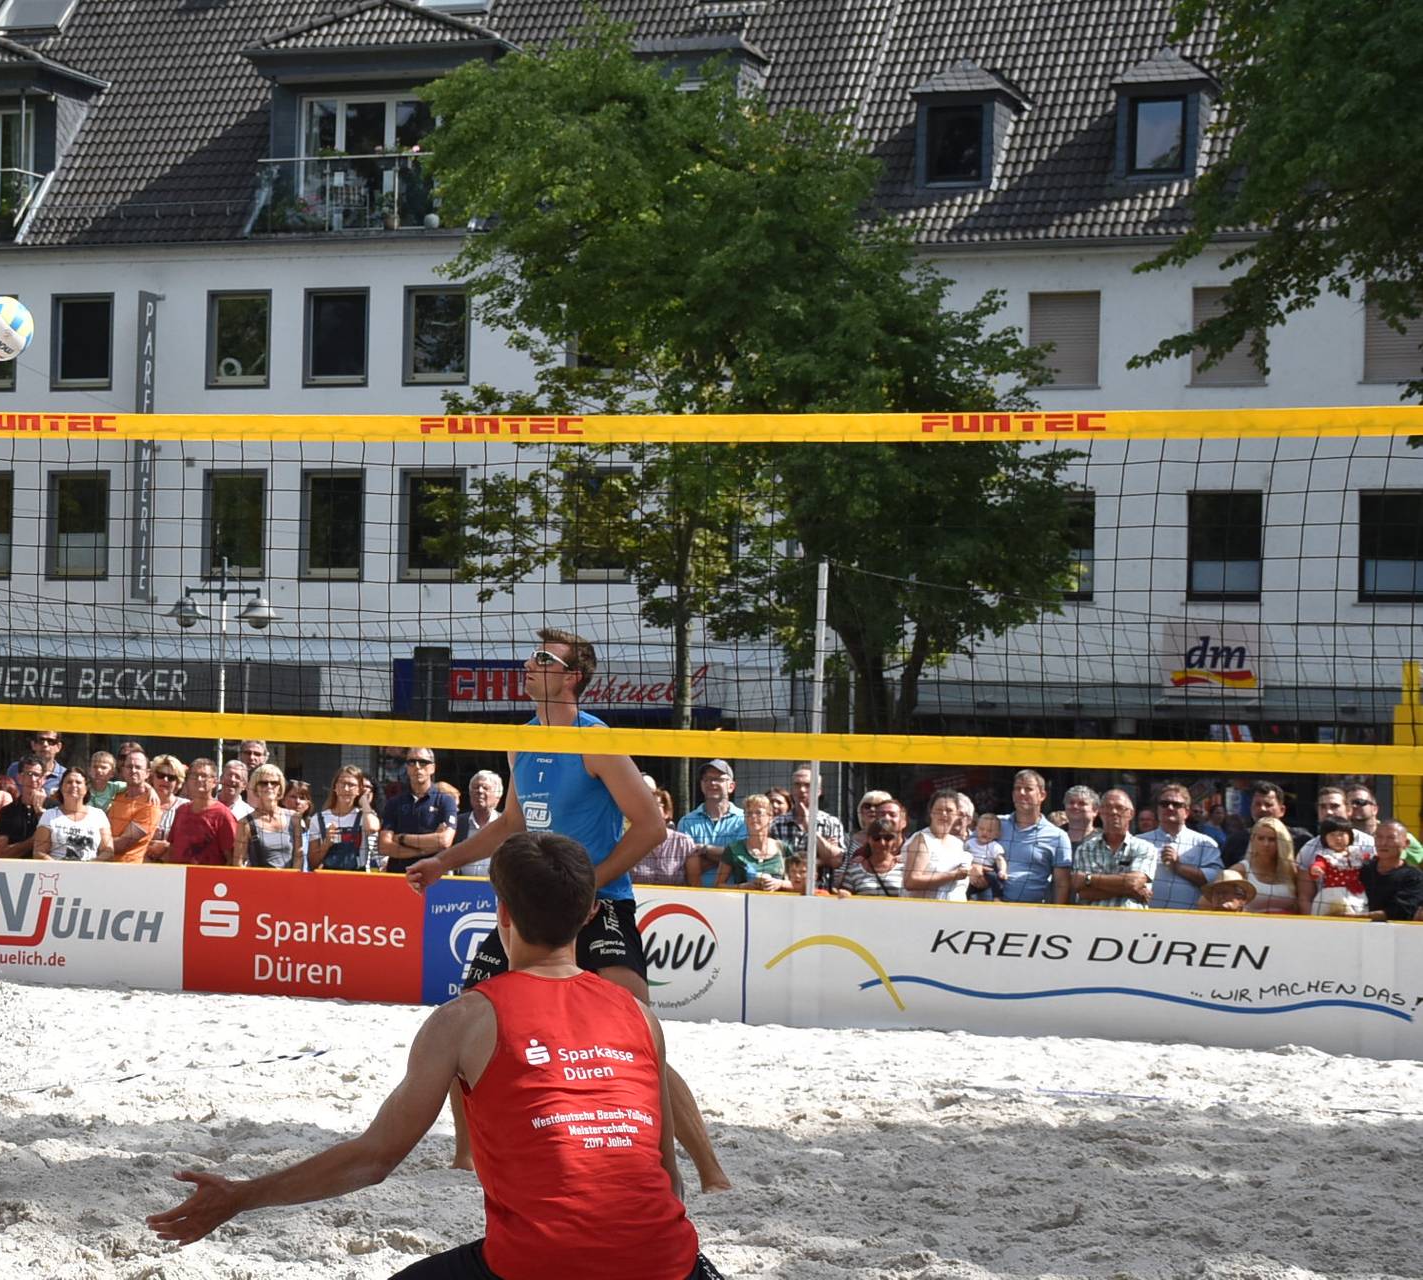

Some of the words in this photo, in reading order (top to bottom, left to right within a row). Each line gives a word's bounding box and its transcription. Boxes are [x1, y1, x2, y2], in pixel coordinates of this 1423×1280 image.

[420, 417, 584, 435] FUNTEC
[921, 413, 1107, 433] FUNTEC
[138, 301, 154, 590] PARFMERIE
[1185, 636, 1247, 669] dm
[77, 668, 188, 701] BECKER
[538, 771, 544, 783] 1
[476, 895, 492, 910] in
[255, 912, 407, 948] Sparkasse
[930, 929, 1073, 961] KREIS
[1087, 932, 1271, 970] DÜREN
[253, 953, 343, 986] Düren
[1211, 987, 1252, 1003] WIR
[1258, 980, 1356, 1001] MACHEN
[1363, 983, 1407, 1008] DAS
[557, 1045, 634, 1063] Sparkasse
[563, 1066, 614, 1081] Düren
[531, 1111, 596, 1129] Westdeutsche
[567, 1121, 639, 1136] Meisterschaften
[583, 1137, 604, 1150] 2017
[606, 1136, 633, 1148] Jülich
